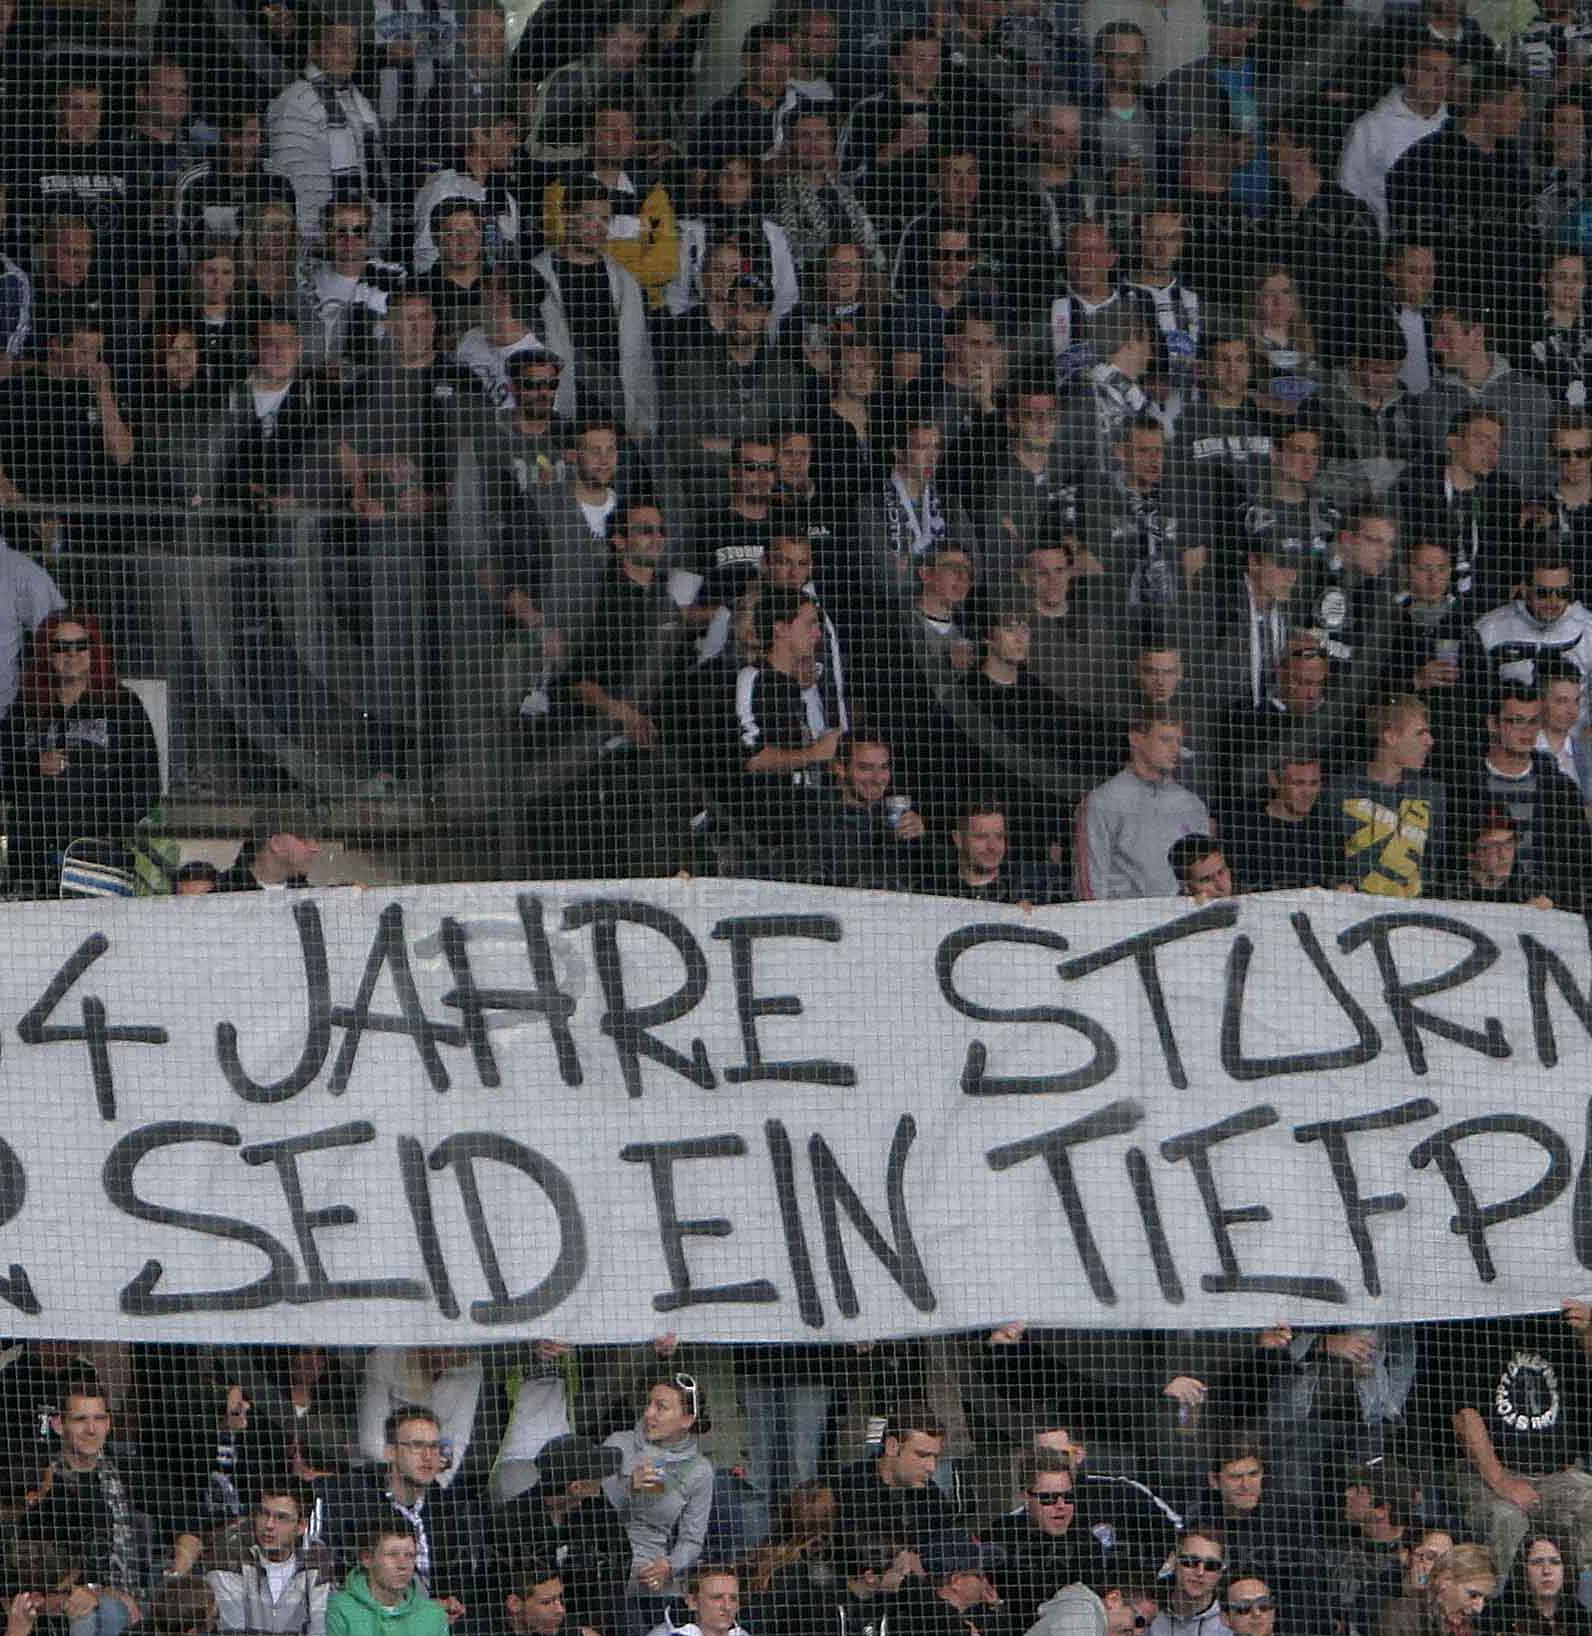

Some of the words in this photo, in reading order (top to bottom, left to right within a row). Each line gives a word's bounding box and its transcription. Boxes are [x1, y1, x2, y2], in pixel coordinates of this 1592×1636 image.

[216, 892, 859, 1104] JAHRE
[102, 1119, 588, 1325] SEID
[620, 1112, 937, 1330] EIN
